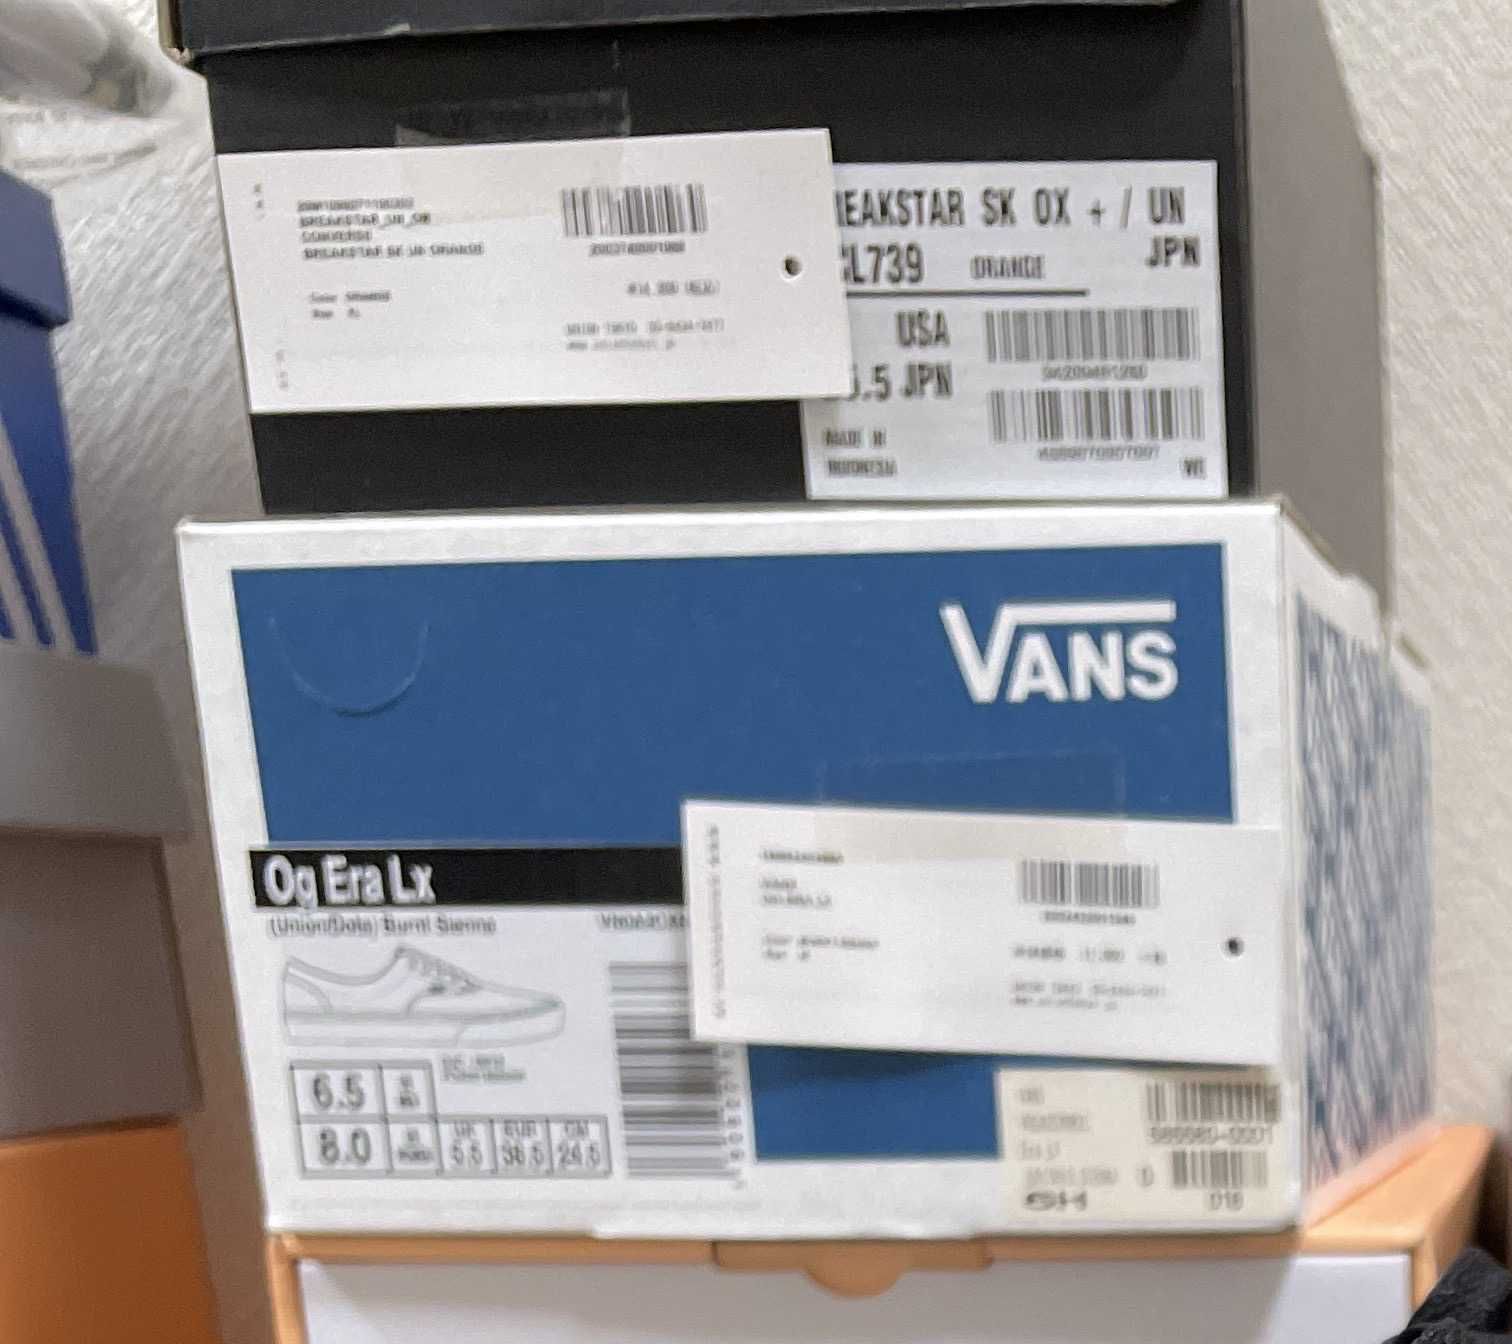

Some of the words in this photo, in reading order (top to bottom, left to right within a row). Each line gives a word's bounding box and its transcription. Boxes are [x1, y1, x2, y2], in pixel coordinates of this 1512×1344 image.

[836, 187, 966, 227] EAKSTAR
[982, 187, 1017, 226] SK
[1148, 186, 1185, 224] UN
[1146, 236, 1200, 267] JPN
[896, 309, 951, 348] USA
[901, 360, 953, 398] JPN
[939, 600, 1179, 704] VANS
[263, 854, 318, 910] Og
[321, 854, 386, 905] Era
[387, 853, 437, 905] Lx
[313, 1072, 366, 1111] 6.5
[318, 1127, 372, 1166] 8.0
